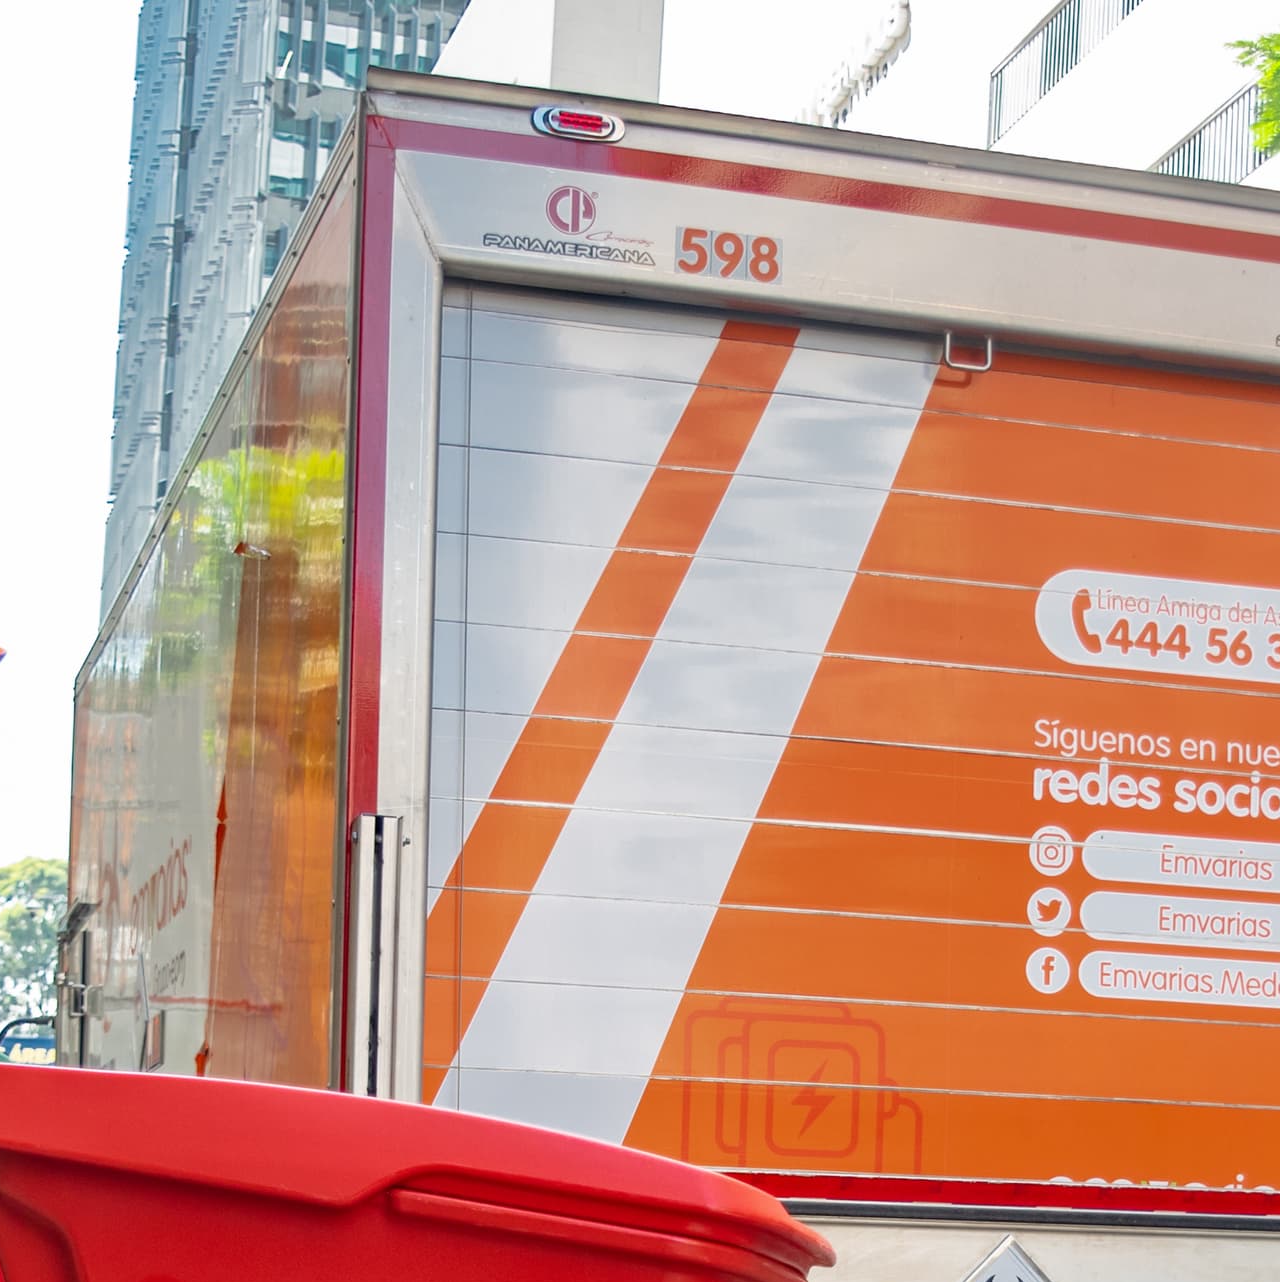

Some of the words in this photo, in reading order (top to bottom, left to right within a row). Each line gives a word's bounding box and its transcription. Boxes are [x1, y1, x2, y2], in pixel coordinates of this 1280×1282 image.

[483, 233, 656, 266] PANAMERICANA
[677, 227, 780, 283] 598
[1097, 588, 1150, 614] Línea
[1156, 595, 1221, 624] Amiga
[1228, 602, 1258, 624] del
[1105, 618, 1191, 660] 444
[1205, 628, 1253, 666] 56
[1033, 719, 1171, 757] Síguenos
[1180, 738, 1216, 761] en
[1033, 757, 1161, 810] redes
[1160, 844, 1273, 881] Emvarias
[1158, 906, 1271, 938] Emvarias
